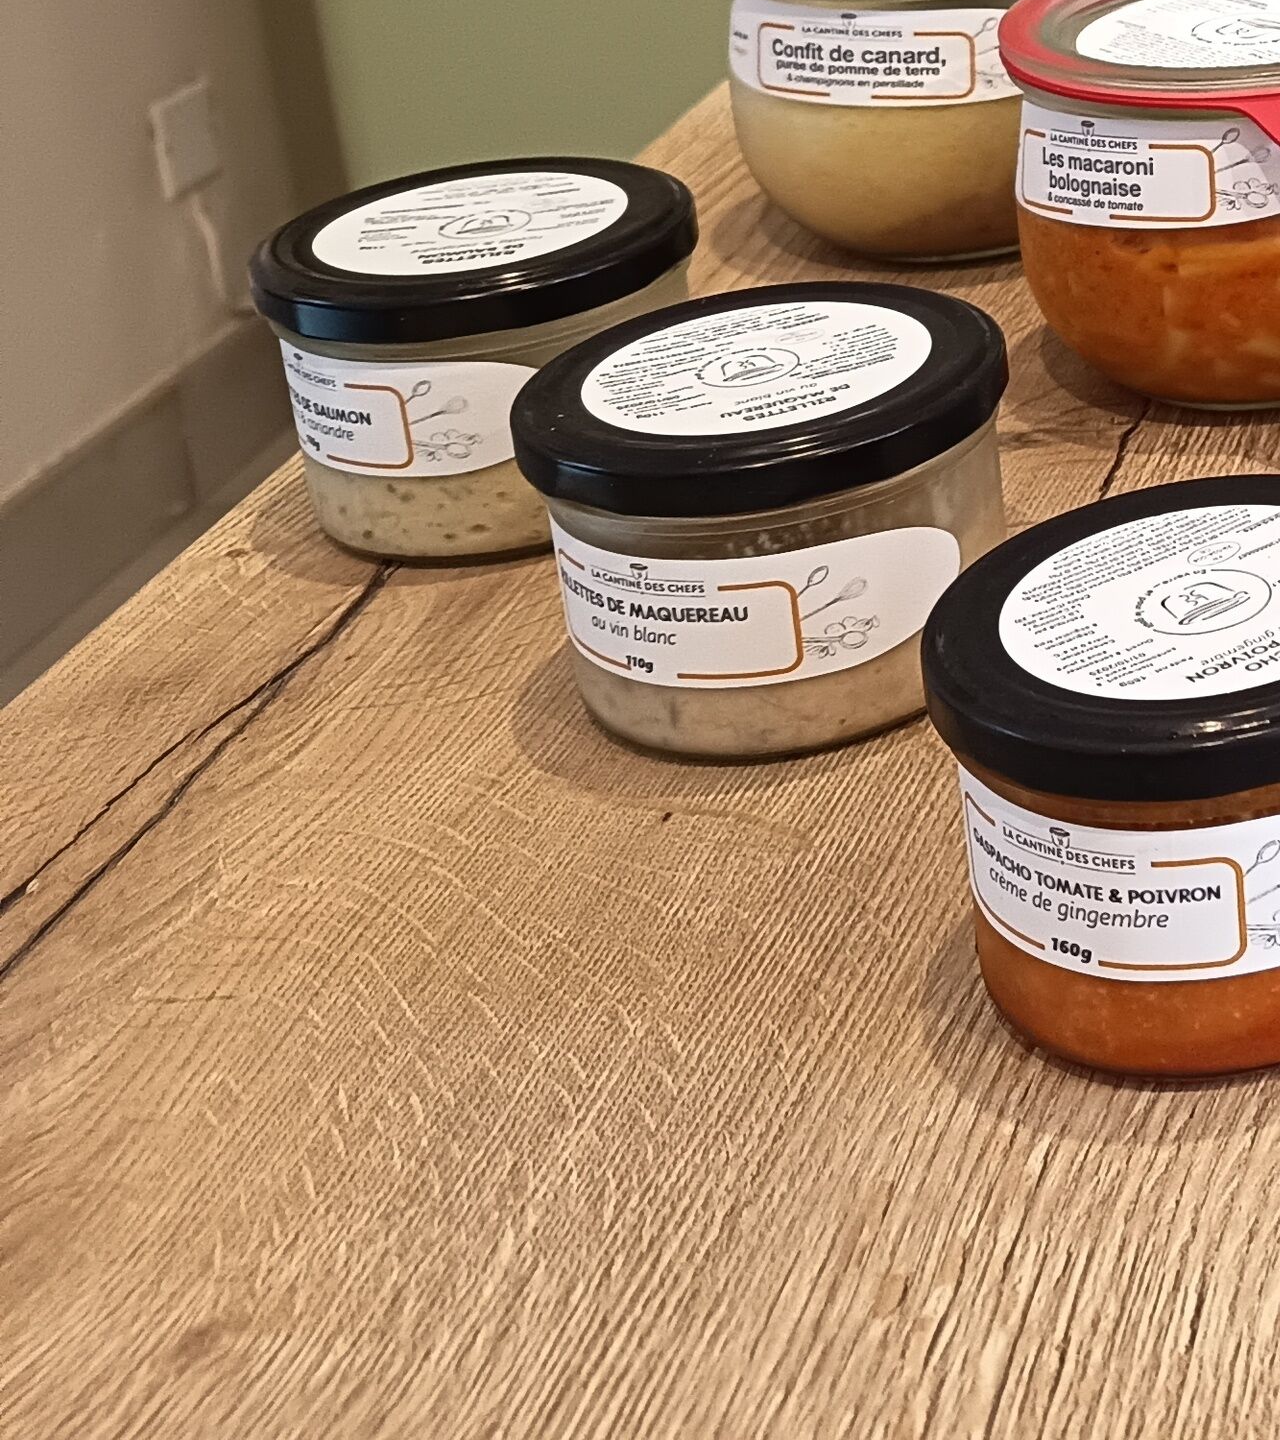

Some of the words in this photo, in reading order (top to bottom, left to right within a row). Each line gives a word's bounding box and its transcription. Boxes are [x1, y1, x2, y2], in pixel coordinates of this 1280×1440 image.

[812, 27, 850, 37] CANTINE
[872, 30, 903, 38] CHEFS
[772, 38, 823, 61] Confit
[829, 45, 854, 63] de
[861, 47, 947, 67] canard,
[794, 75, 855, 88] champignons
[857, 79, 871, 87] en
[873, 79, 924, 89] persillade
[809, 62, 825, 72] de
[828, 65, 879, 76] pomme
[883, 65, 901, 76] de
[905, 65, 941, 76] terre
[1050, 133, 1058, 142] LA
[1058, 135, 1089, 147] CANTINE
[1090, 138, 1106, 148] DES
[1108, 140, 1138, 150] CHEFS
[1042, 146, 1065, 168] Les
[1068, 155, 1154, 176] macaroni
[1049, 170, 1142, 197] bolognaise
[1054, 194, 1092, 208] concassé
[1093, 198, 1106, 209] de
[1107, 199, 1144, 211] tomate
[313, 402, 372, 426] SAUMON
[591, 568, 601, 579] LA
[602, 572, 642, 590] CANTINE
[644, 580, 665, 592] DES
[667, 583, 705, 594] CHEFS
[607, 596, 625, 615] DE
[630, 602, 748, 623] MAQUEREAU
[592, 615, 606, 630] au
[610, 620, 629, 638] vin
[634, 624, 677, 646] blanc
[625, 655, 654, 674] 110g
[1185, 640, 1280, 683] POIVRON
[1002, 826, 1016, 841] LA
[1015, 833, 1063, 859] CANTINE
[1065, 850, 1089, 866] DES
[1092, 856, 1136, 871] CHEFS
[973, 827, 1032, 881] GASPACHO
[1034, 871, 1103, 902] TOMATE
[1108, 888, 1123, 903] &
[1128, 885, 1221, 905] POIVRON
[989, 866, 1028, 902] crème
[1032, 890, 1052, 912] de
[1057, 900, 1169, 929] gingembre
[1050, 937, 1093, 965] 160g
